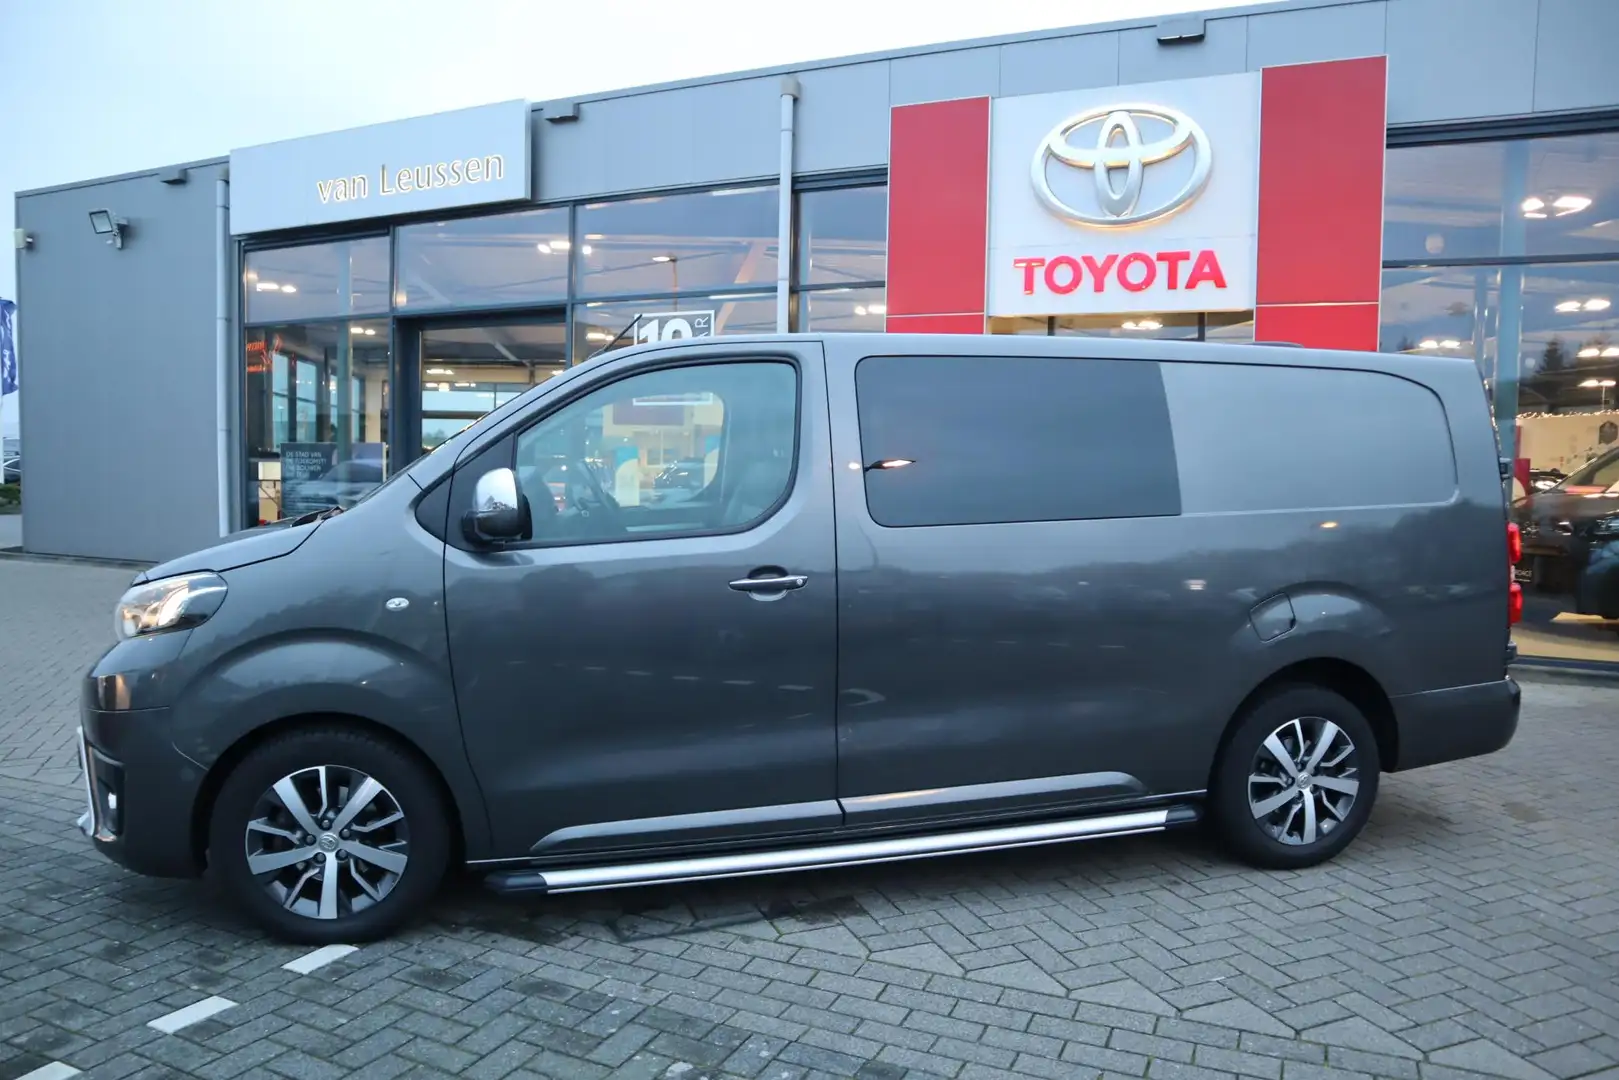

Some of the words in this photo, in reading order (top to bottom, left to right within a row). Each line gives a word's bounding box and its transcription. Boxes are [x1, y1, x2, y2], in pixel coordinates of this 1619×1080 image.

[317, 174, 368, 204] van
[379, 153, 504, 196] Leussen
[1013, 250, 1227, 295] TOYOTA
